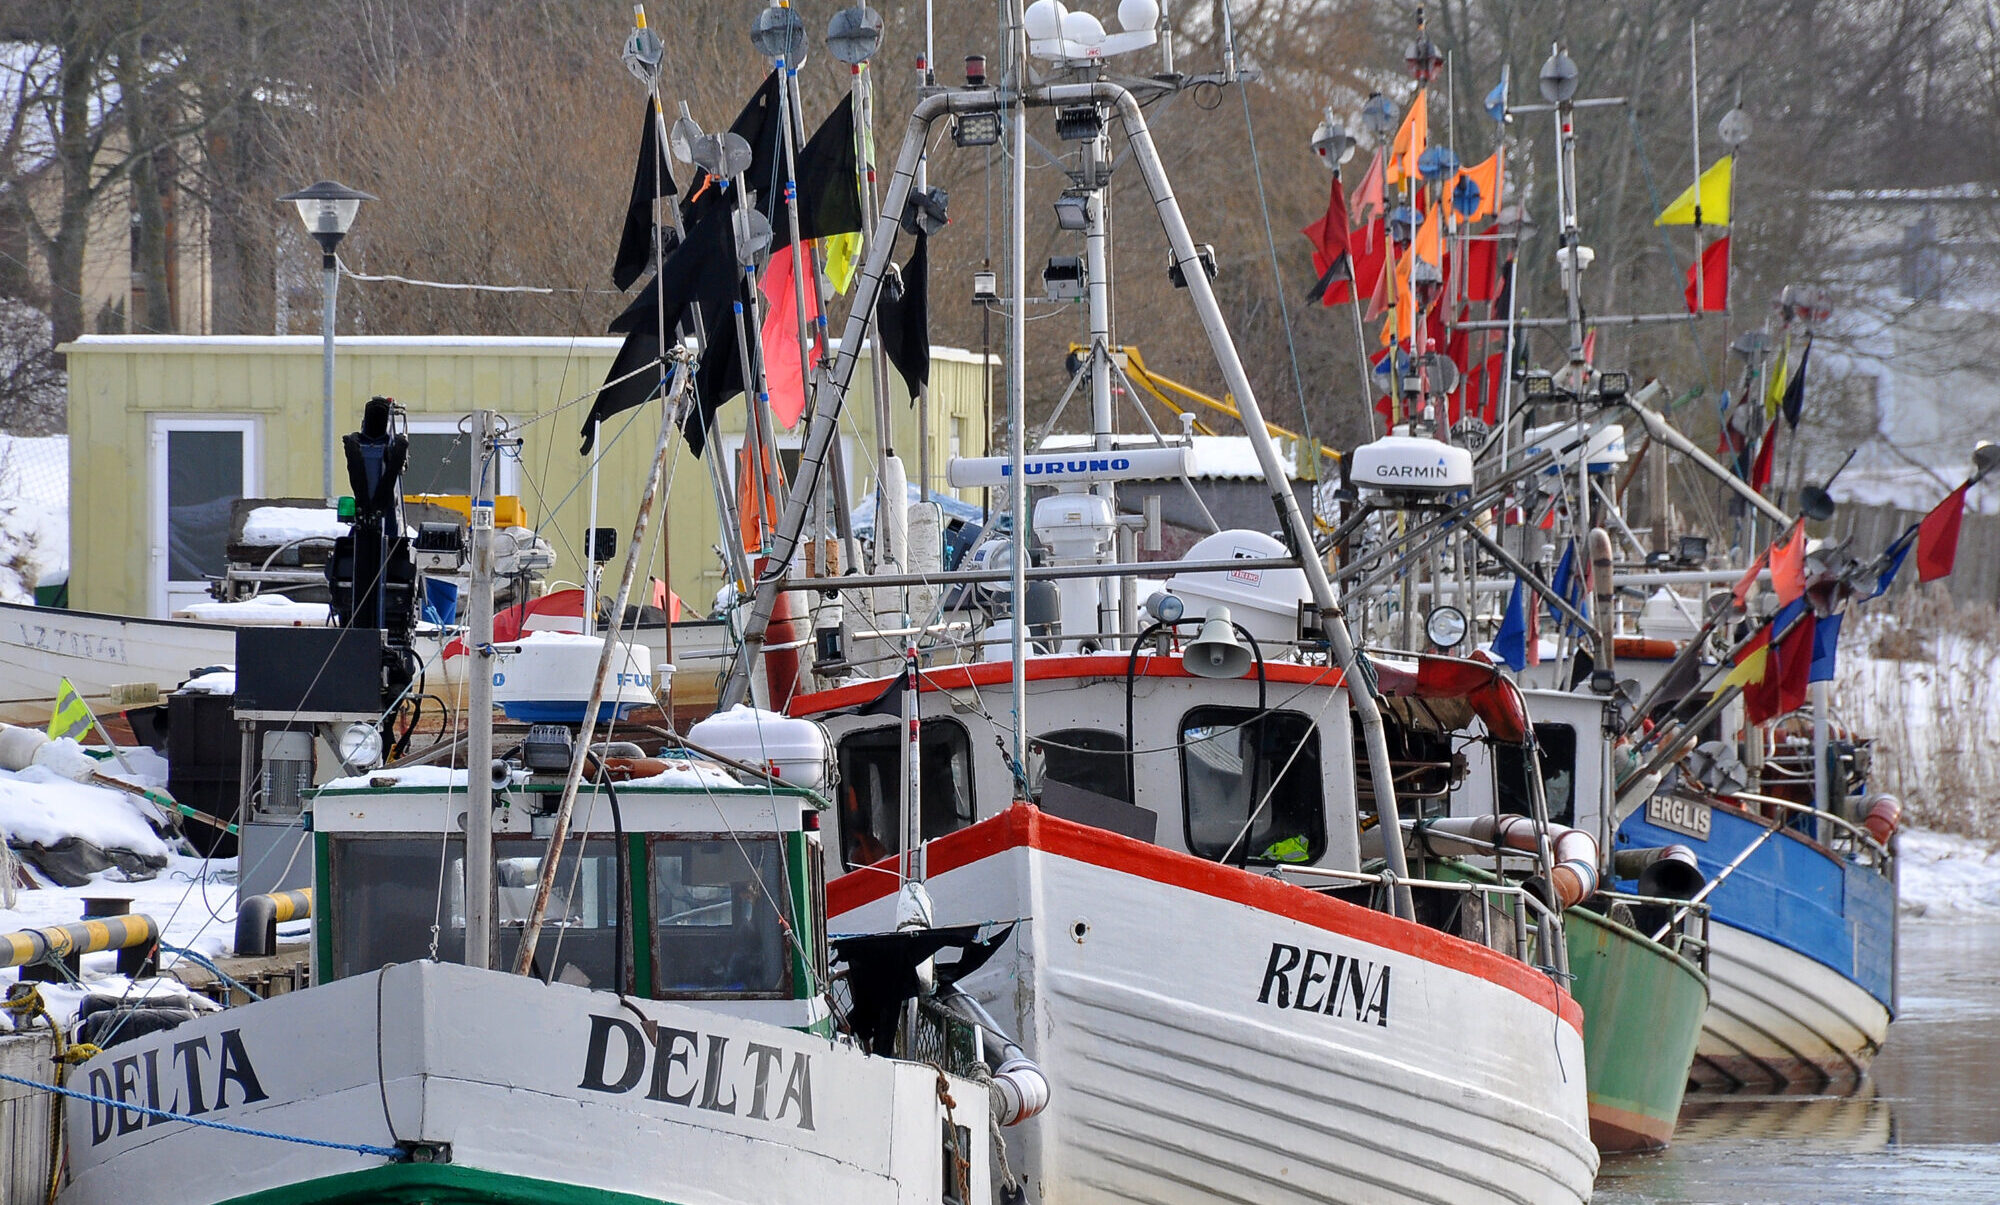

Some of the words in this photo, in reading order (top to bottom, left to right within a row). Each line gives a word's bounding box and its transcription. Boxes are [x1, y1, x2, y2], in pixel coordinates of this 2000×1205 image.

[1377, 465, 1447, 478] GARMIN
[1651, 795, 1711, 834] ERGLIS
[1257, 942, 1391, 1028] REINA
[88, 1028, 269, 1147] DELTA
[577, 1014, 816, 1131] DELTA
